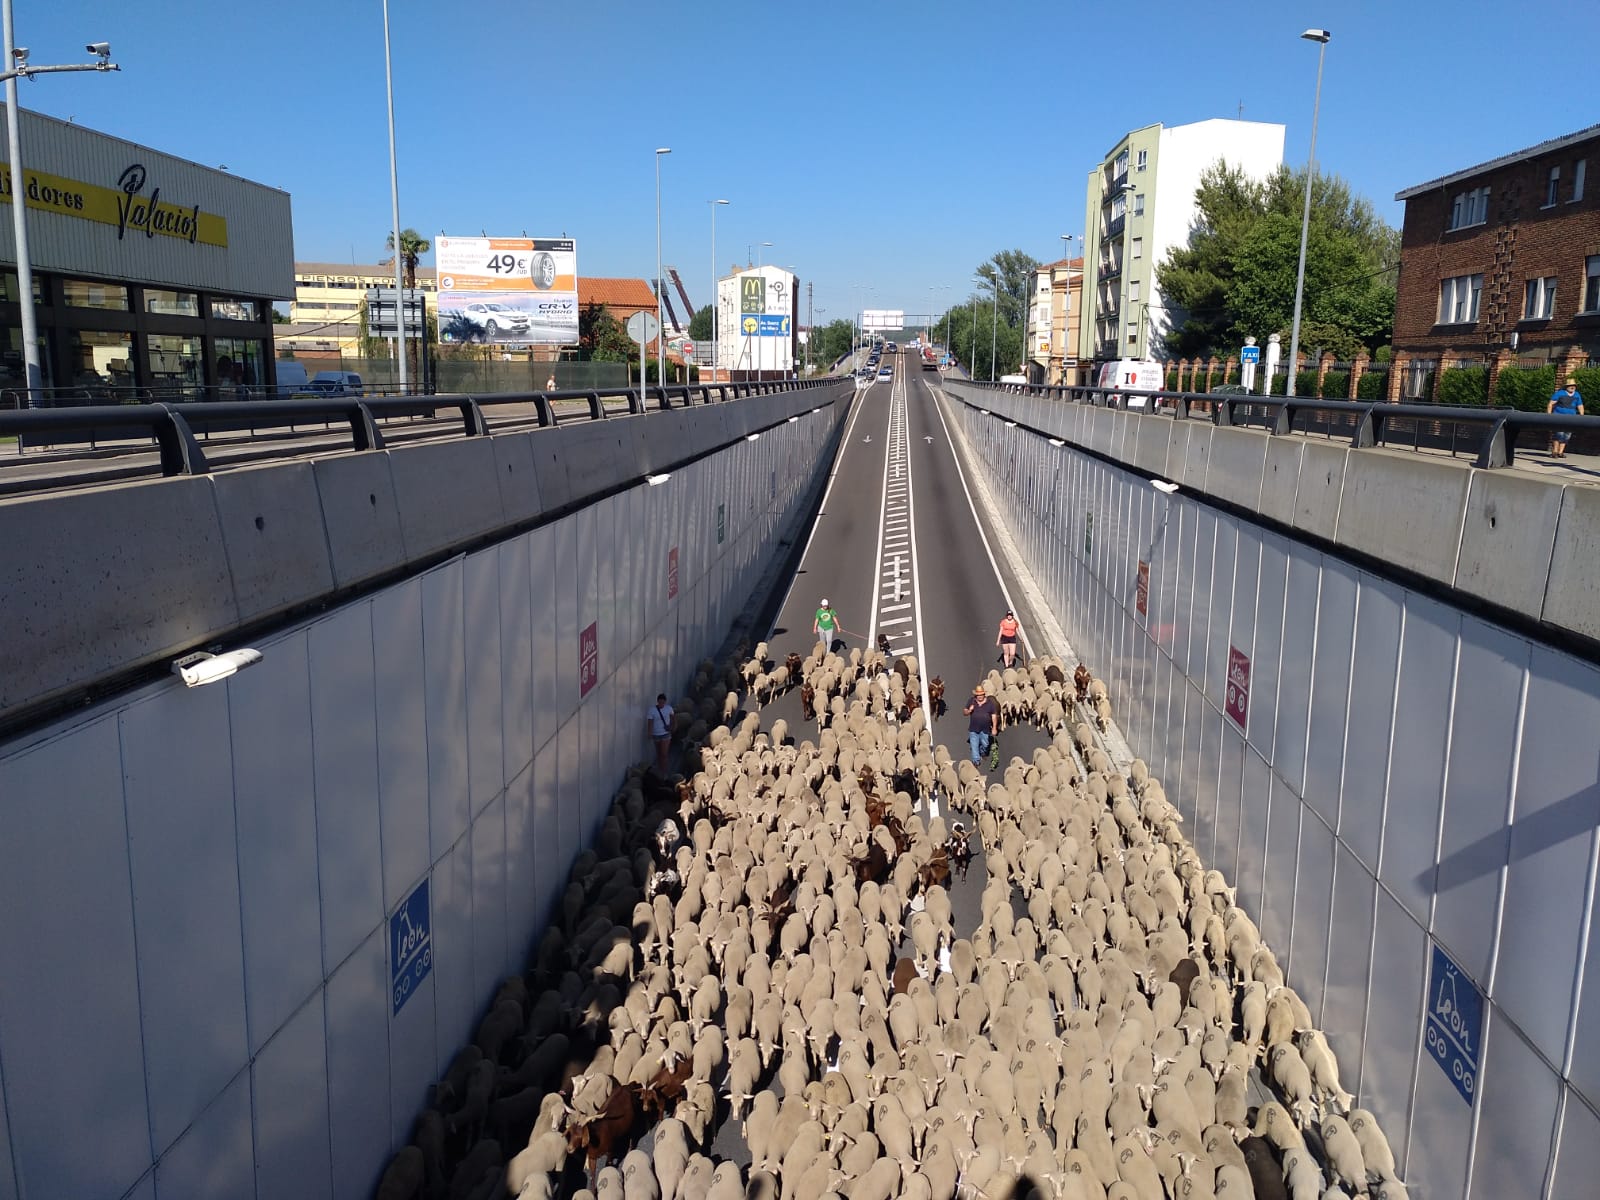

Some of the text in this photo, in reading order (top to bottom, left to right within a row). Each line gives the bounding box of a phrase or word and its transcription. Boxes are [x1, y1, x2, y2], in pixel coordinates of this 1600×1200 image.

[117, 164, 199, 244] Palacios
[302, 275, 365, 284] PIENSOS
[1123, 372, 1131, 384] I
